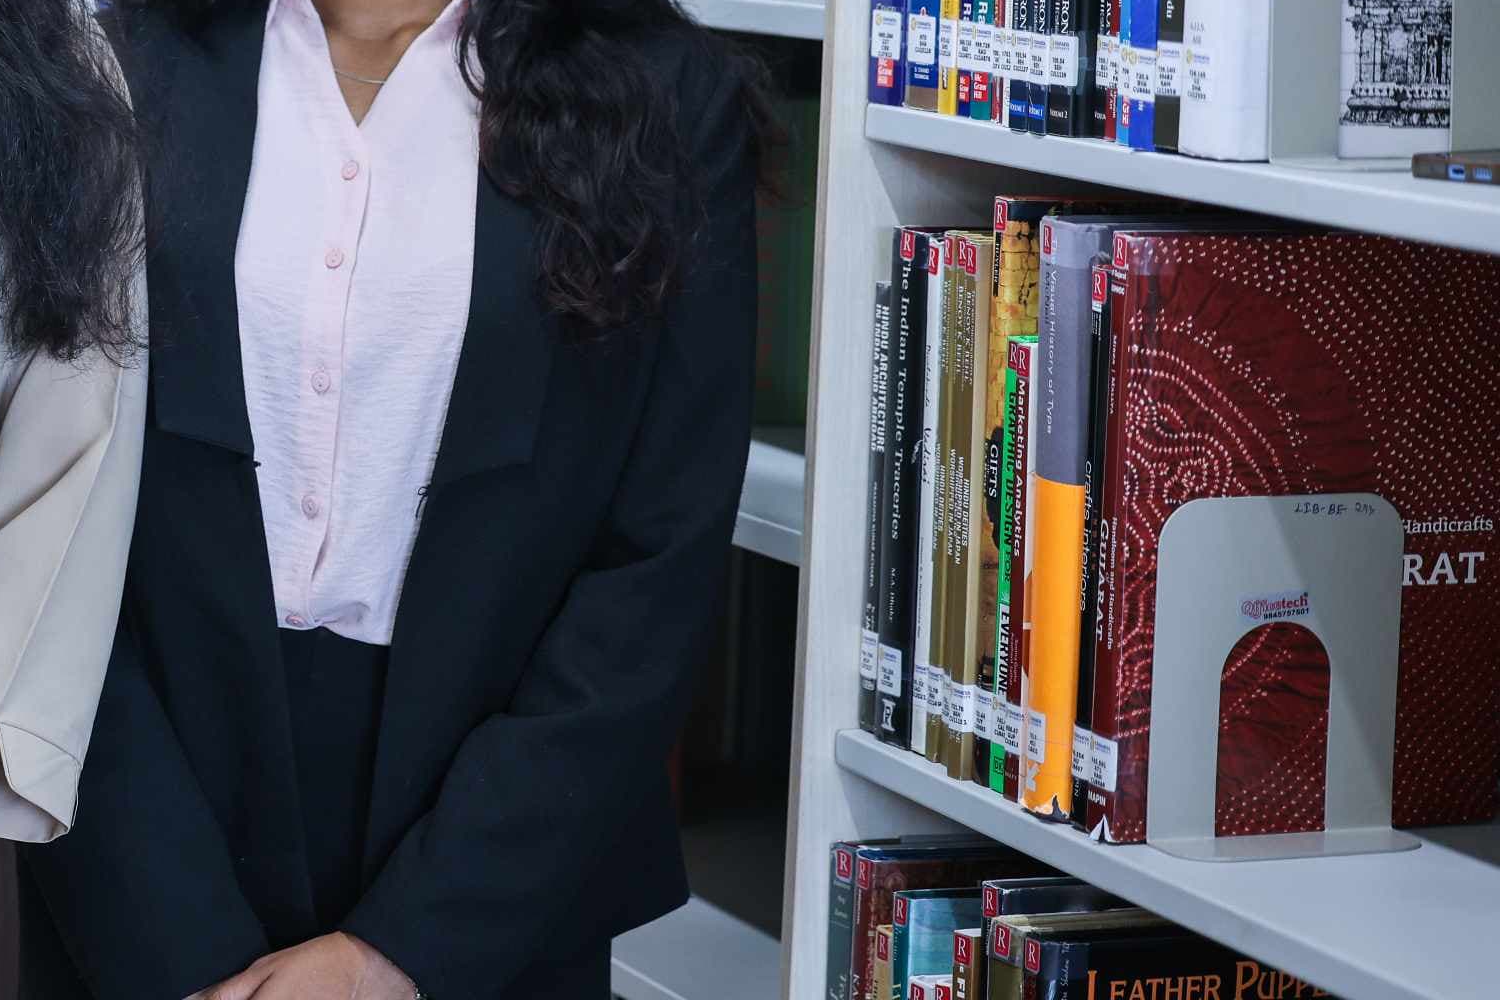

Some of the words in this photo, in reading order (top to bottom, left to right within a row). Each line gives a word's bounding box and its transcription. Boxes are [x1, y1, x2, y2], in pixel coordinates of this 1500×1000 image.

[1049, 270, 1057, 316] Visual
[880, 305, 890, 350] HINDU
[899, 296, 911, 361] Indian
[1046, 321, 1056, 374] History
[870, 396, 878, 452] ABROAD
[876, 353, 888, 453] ARCHITECTURE
[894, 368, 908, 442] Temple
[1006, 391, 1016, 472] GRAPHIC
[1014, 379, 1026, 470] Marketing
[1046, 399, 1054, 434] Type
[891, 448, 904, 540] Traceries
[988, 444, 999, 498] GIFTS
[1084, 460, 1093, 521] crafts
[961, 510, 969, 547] DEITIES
[1003, 478, 1014, 546] DESIGN
[1013, 474, 1024, 557] Analytics
[1080, 528, 1092, 612] interiors
[1109, 516, 1118, 569] Handloom
[1402, 551, 1485, 586] RAT
[1107, 593, 1116, 650] Handicrafts
[997, 611, 1011, 696] EVERYONE
[1087, 970, 1222, 1000] LEATHER
